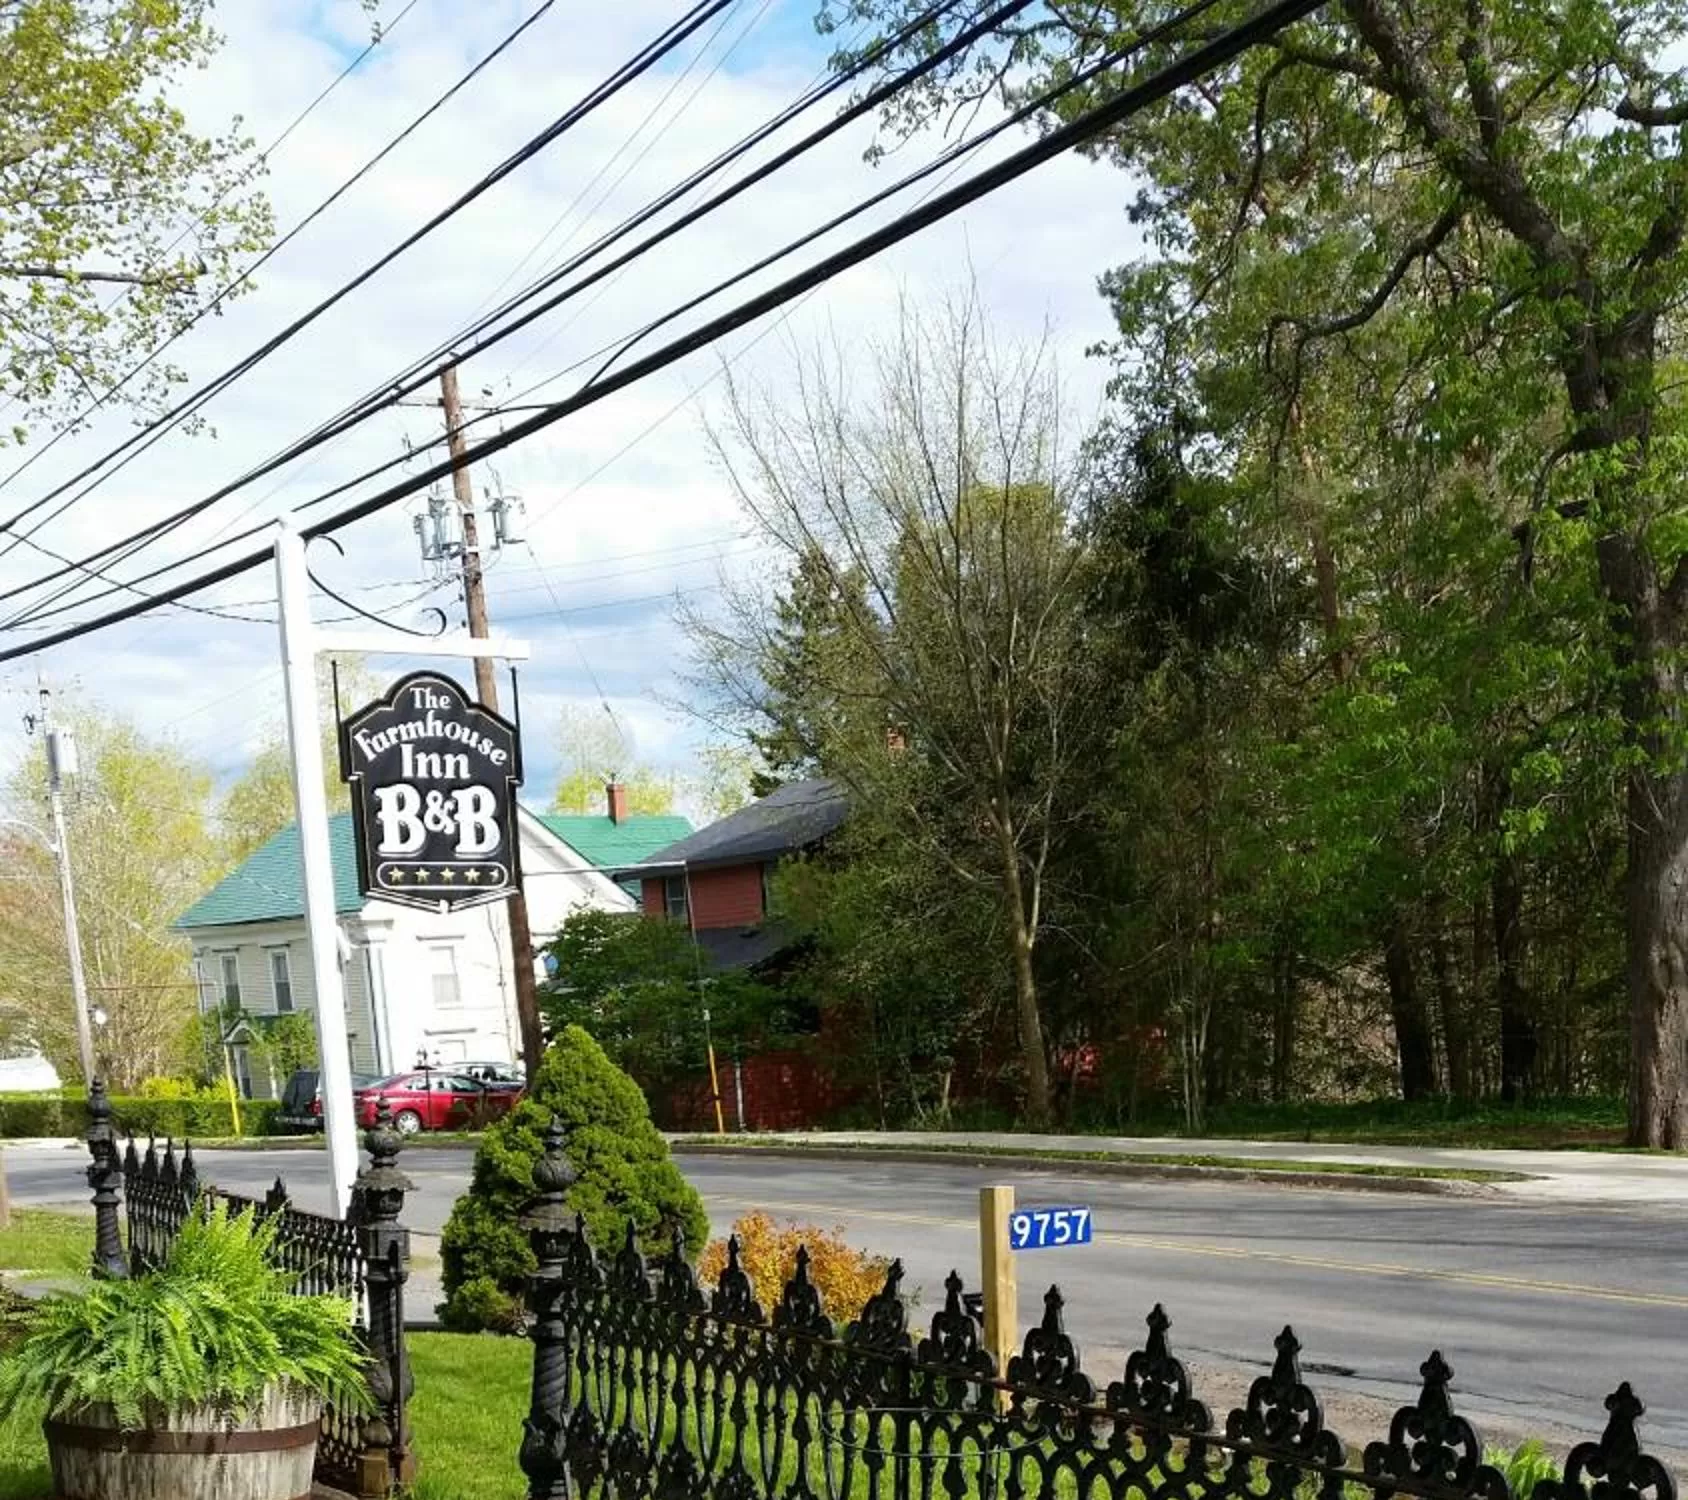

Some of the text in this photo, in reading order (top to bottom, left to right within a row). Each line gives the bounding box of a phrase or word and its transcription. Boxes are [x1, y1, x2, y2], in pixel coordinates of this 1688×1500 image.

[410, 687, 450, 709] The
[354, 710, 507, 765] Farmhouse
[400, 744, 470, 778] Inn
[374, 783, 500, 856] B&B
[1013, 1209, 1089, 1246] 9757
